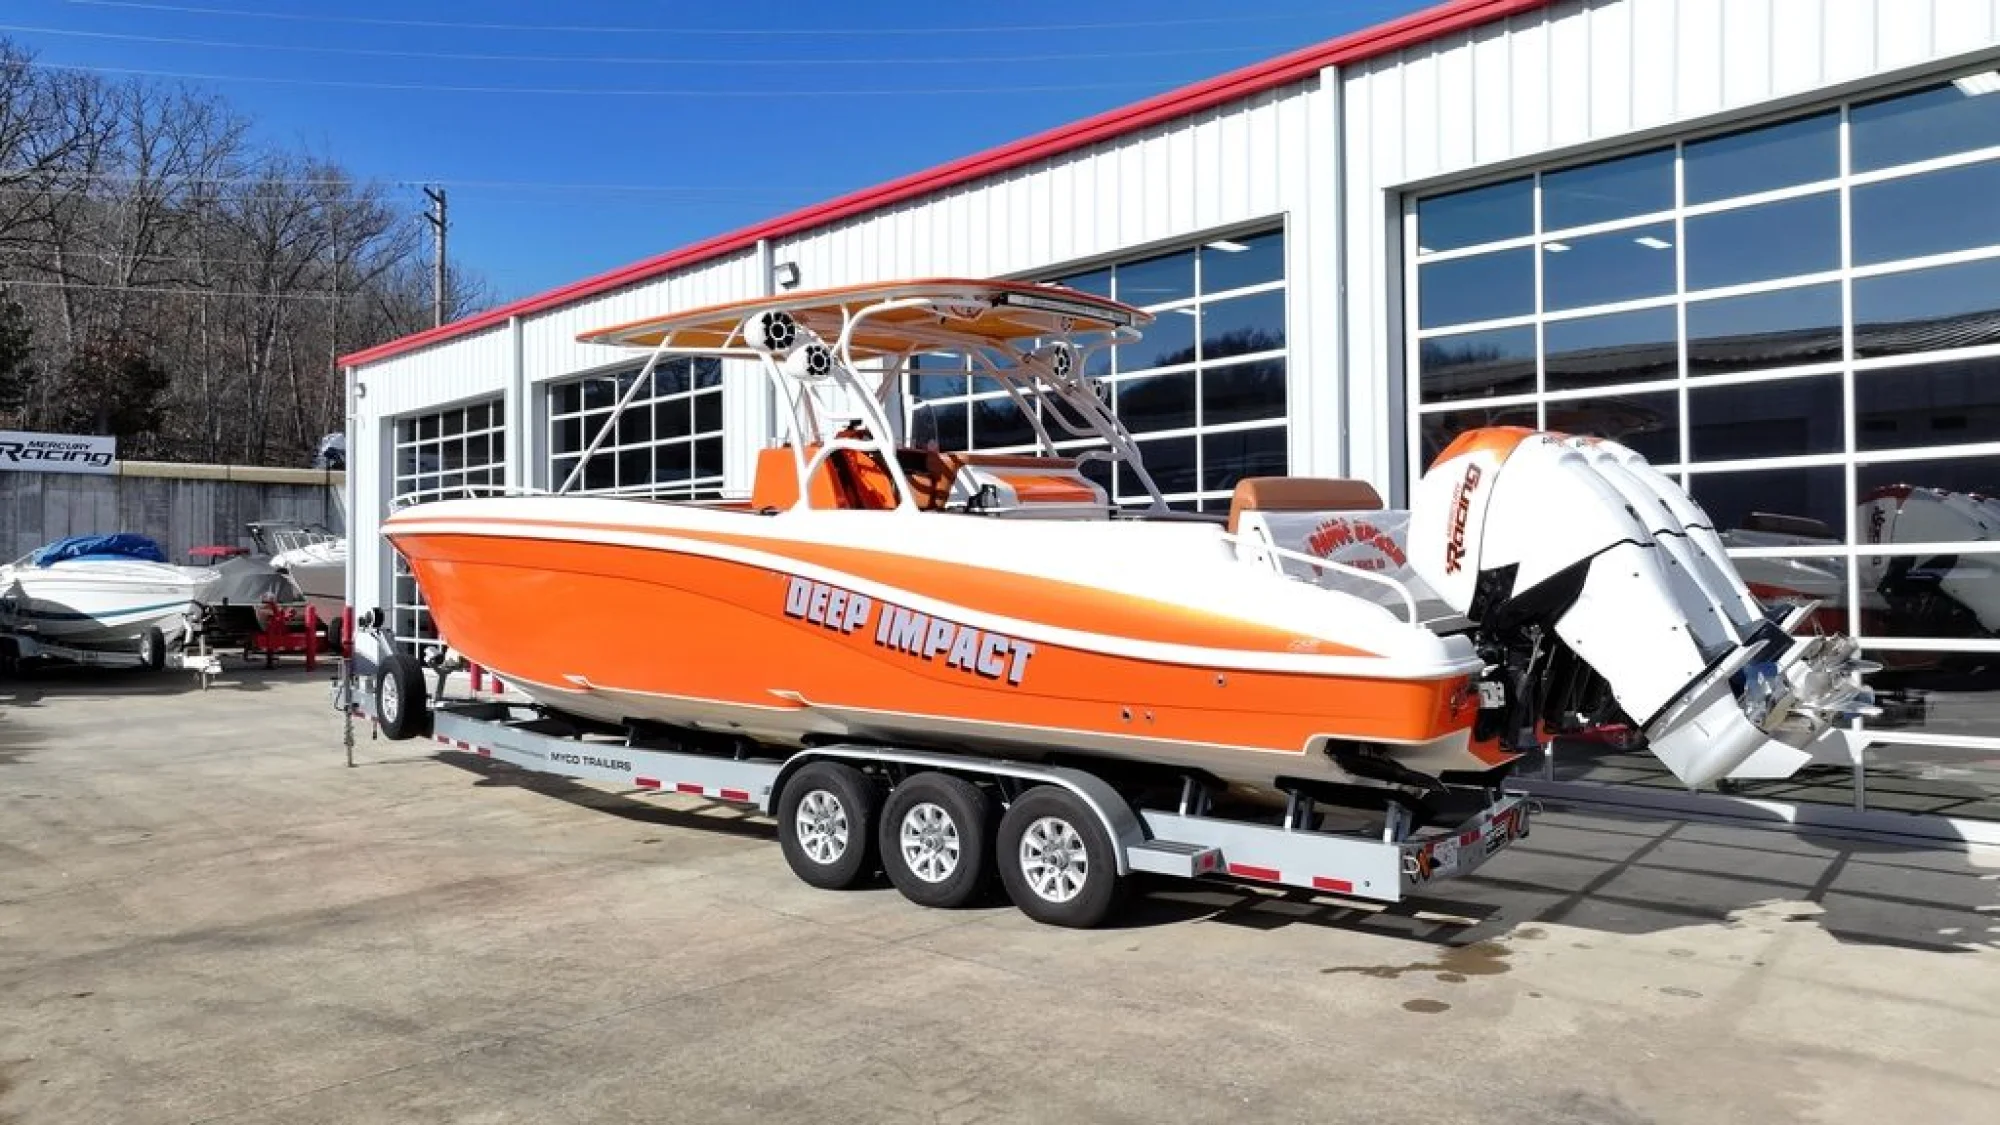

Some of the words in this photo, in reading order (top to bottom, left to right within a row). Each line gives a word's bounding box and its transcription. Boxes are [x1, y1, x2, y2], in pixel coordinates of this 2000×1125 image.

[0, 443, 113, 467] Racing
[27, 441, 93, 450] MERCURY
[1445, 462, 1482, 575] Racing
[784, 575, 872, 636] DEEP
[875, 603, 1036, 687] IMPACT
[550, 752, 579, 765] MYCO
[583, 756, 632, 772] TRAILERS
